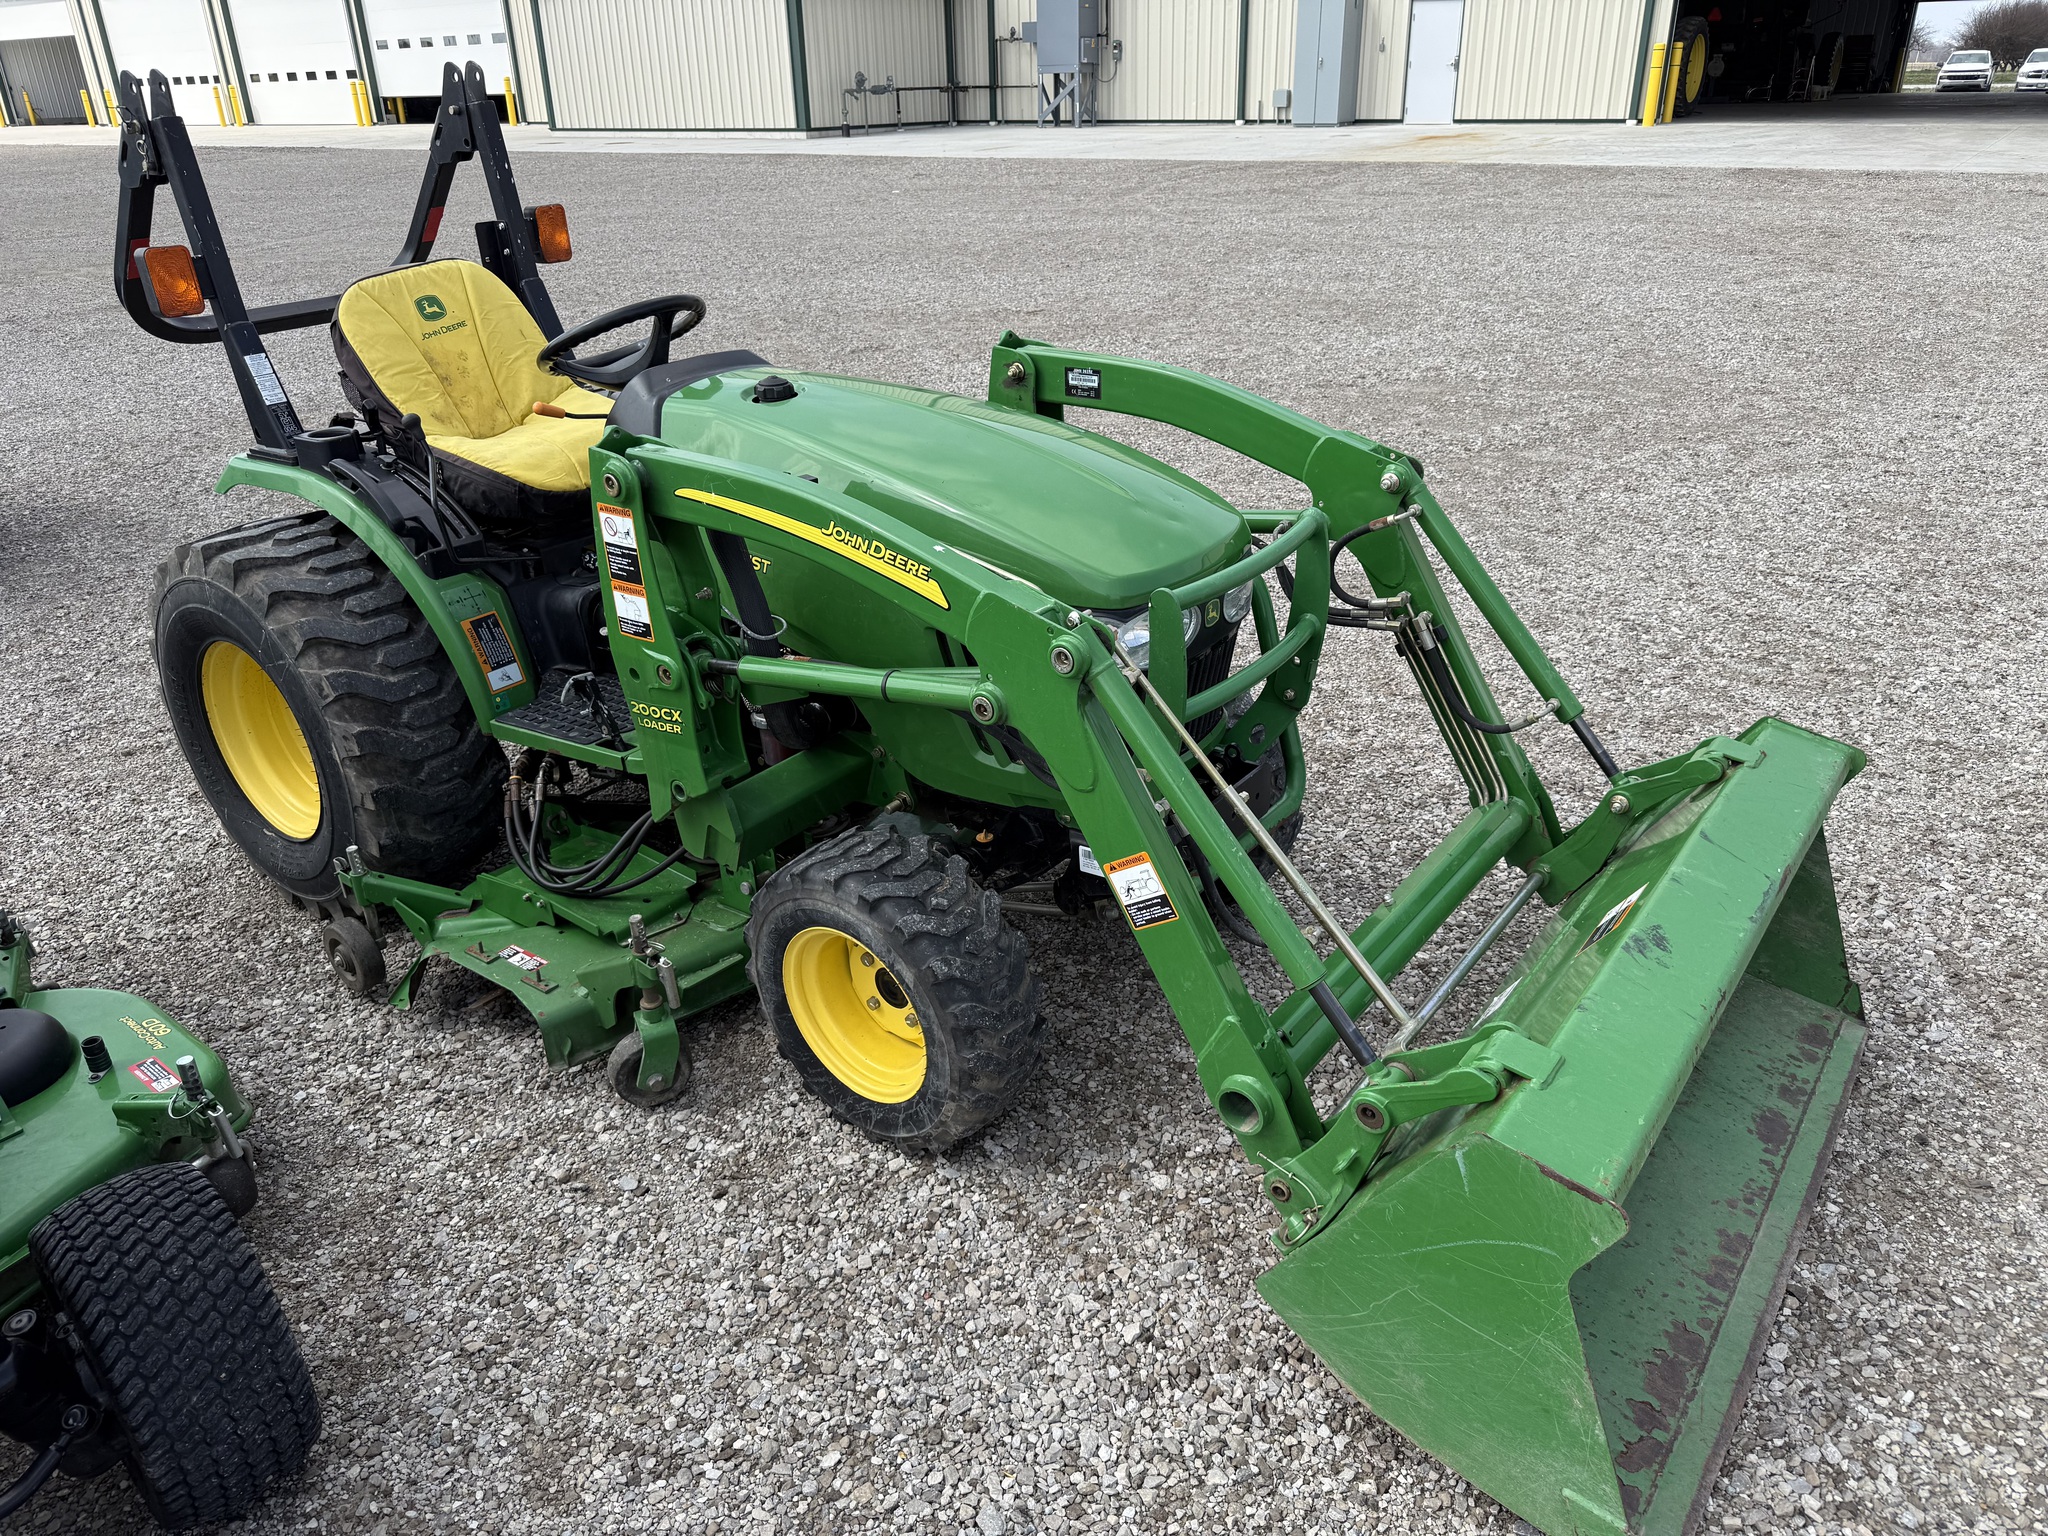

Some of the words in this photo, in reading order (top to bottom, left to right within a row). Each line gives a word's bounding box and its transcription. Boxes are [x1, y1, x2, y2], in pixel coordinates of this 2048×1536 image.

[421, 328, 441, 341] JOHN
[440, 320, 468, 335] DEERE
[603, 505, 631, 517] WARNING
[820, 520, 869, 553] JOHN
[870, 541, 932, 581] DEERE
[751, 554, 772, 574] ST
[617, 584, 645, 597] WARNING
[466, 627, 485, 659] WARNING
[630, 701, 683, 723] 200CX
[637, 716, 682, 735] LOADER
[1116, 855, 1145, 869] WARNING
[118, 1015, 168, 1050] AutoConnect
[141, 1018, 172, 1036] 60D
